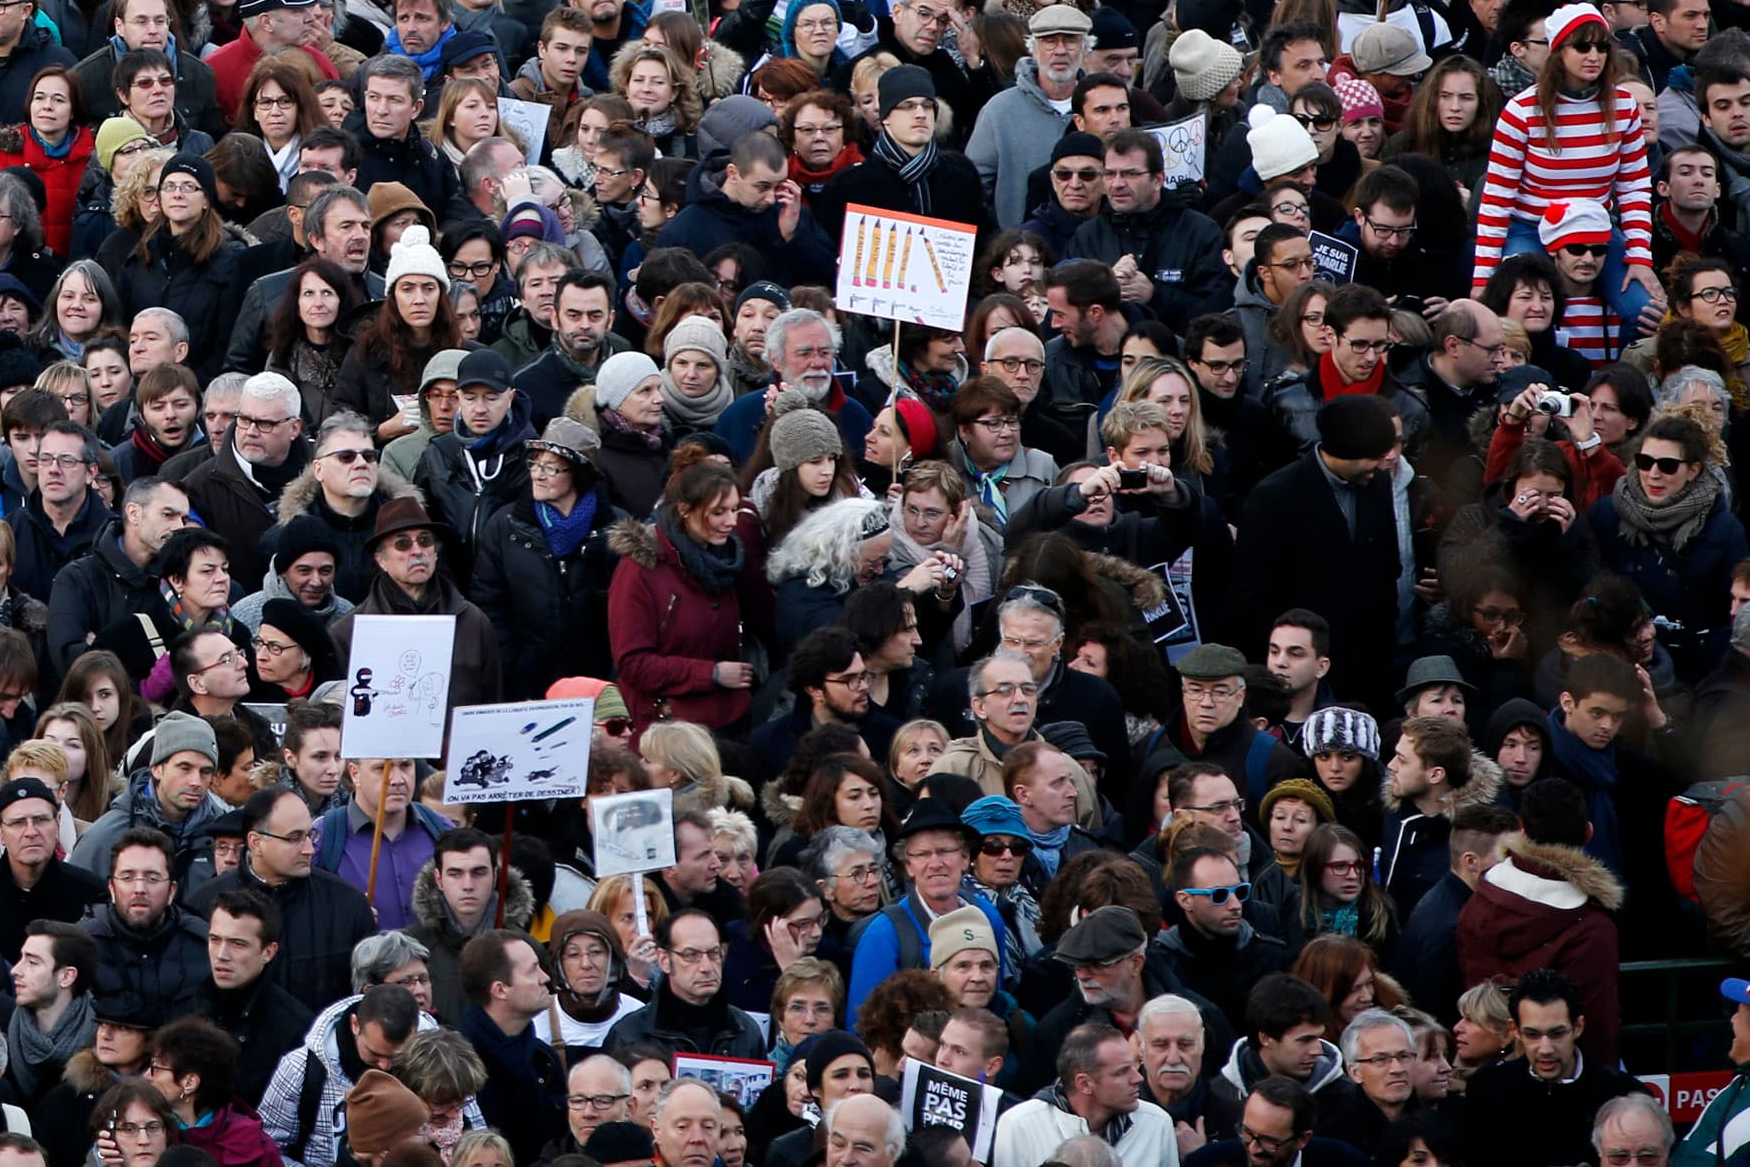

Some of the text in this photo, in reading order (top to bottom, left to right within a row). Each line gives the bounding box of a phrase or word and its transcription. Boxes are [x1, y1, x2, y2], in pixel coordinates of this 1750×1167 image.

[1315, 244, 1349, 263] JE SUIS
[447, 794, 459, 802] ON
[472, 792, 486, 801] PAS
[488, 790, 524, 801] ARRÊTER
[524, 791, 534, 799] DE
[536, 789, 575, 797] DESSINER
[928, 1080, 968, 1105] MÊME
[922, 1094, 967, 1122] PAS
